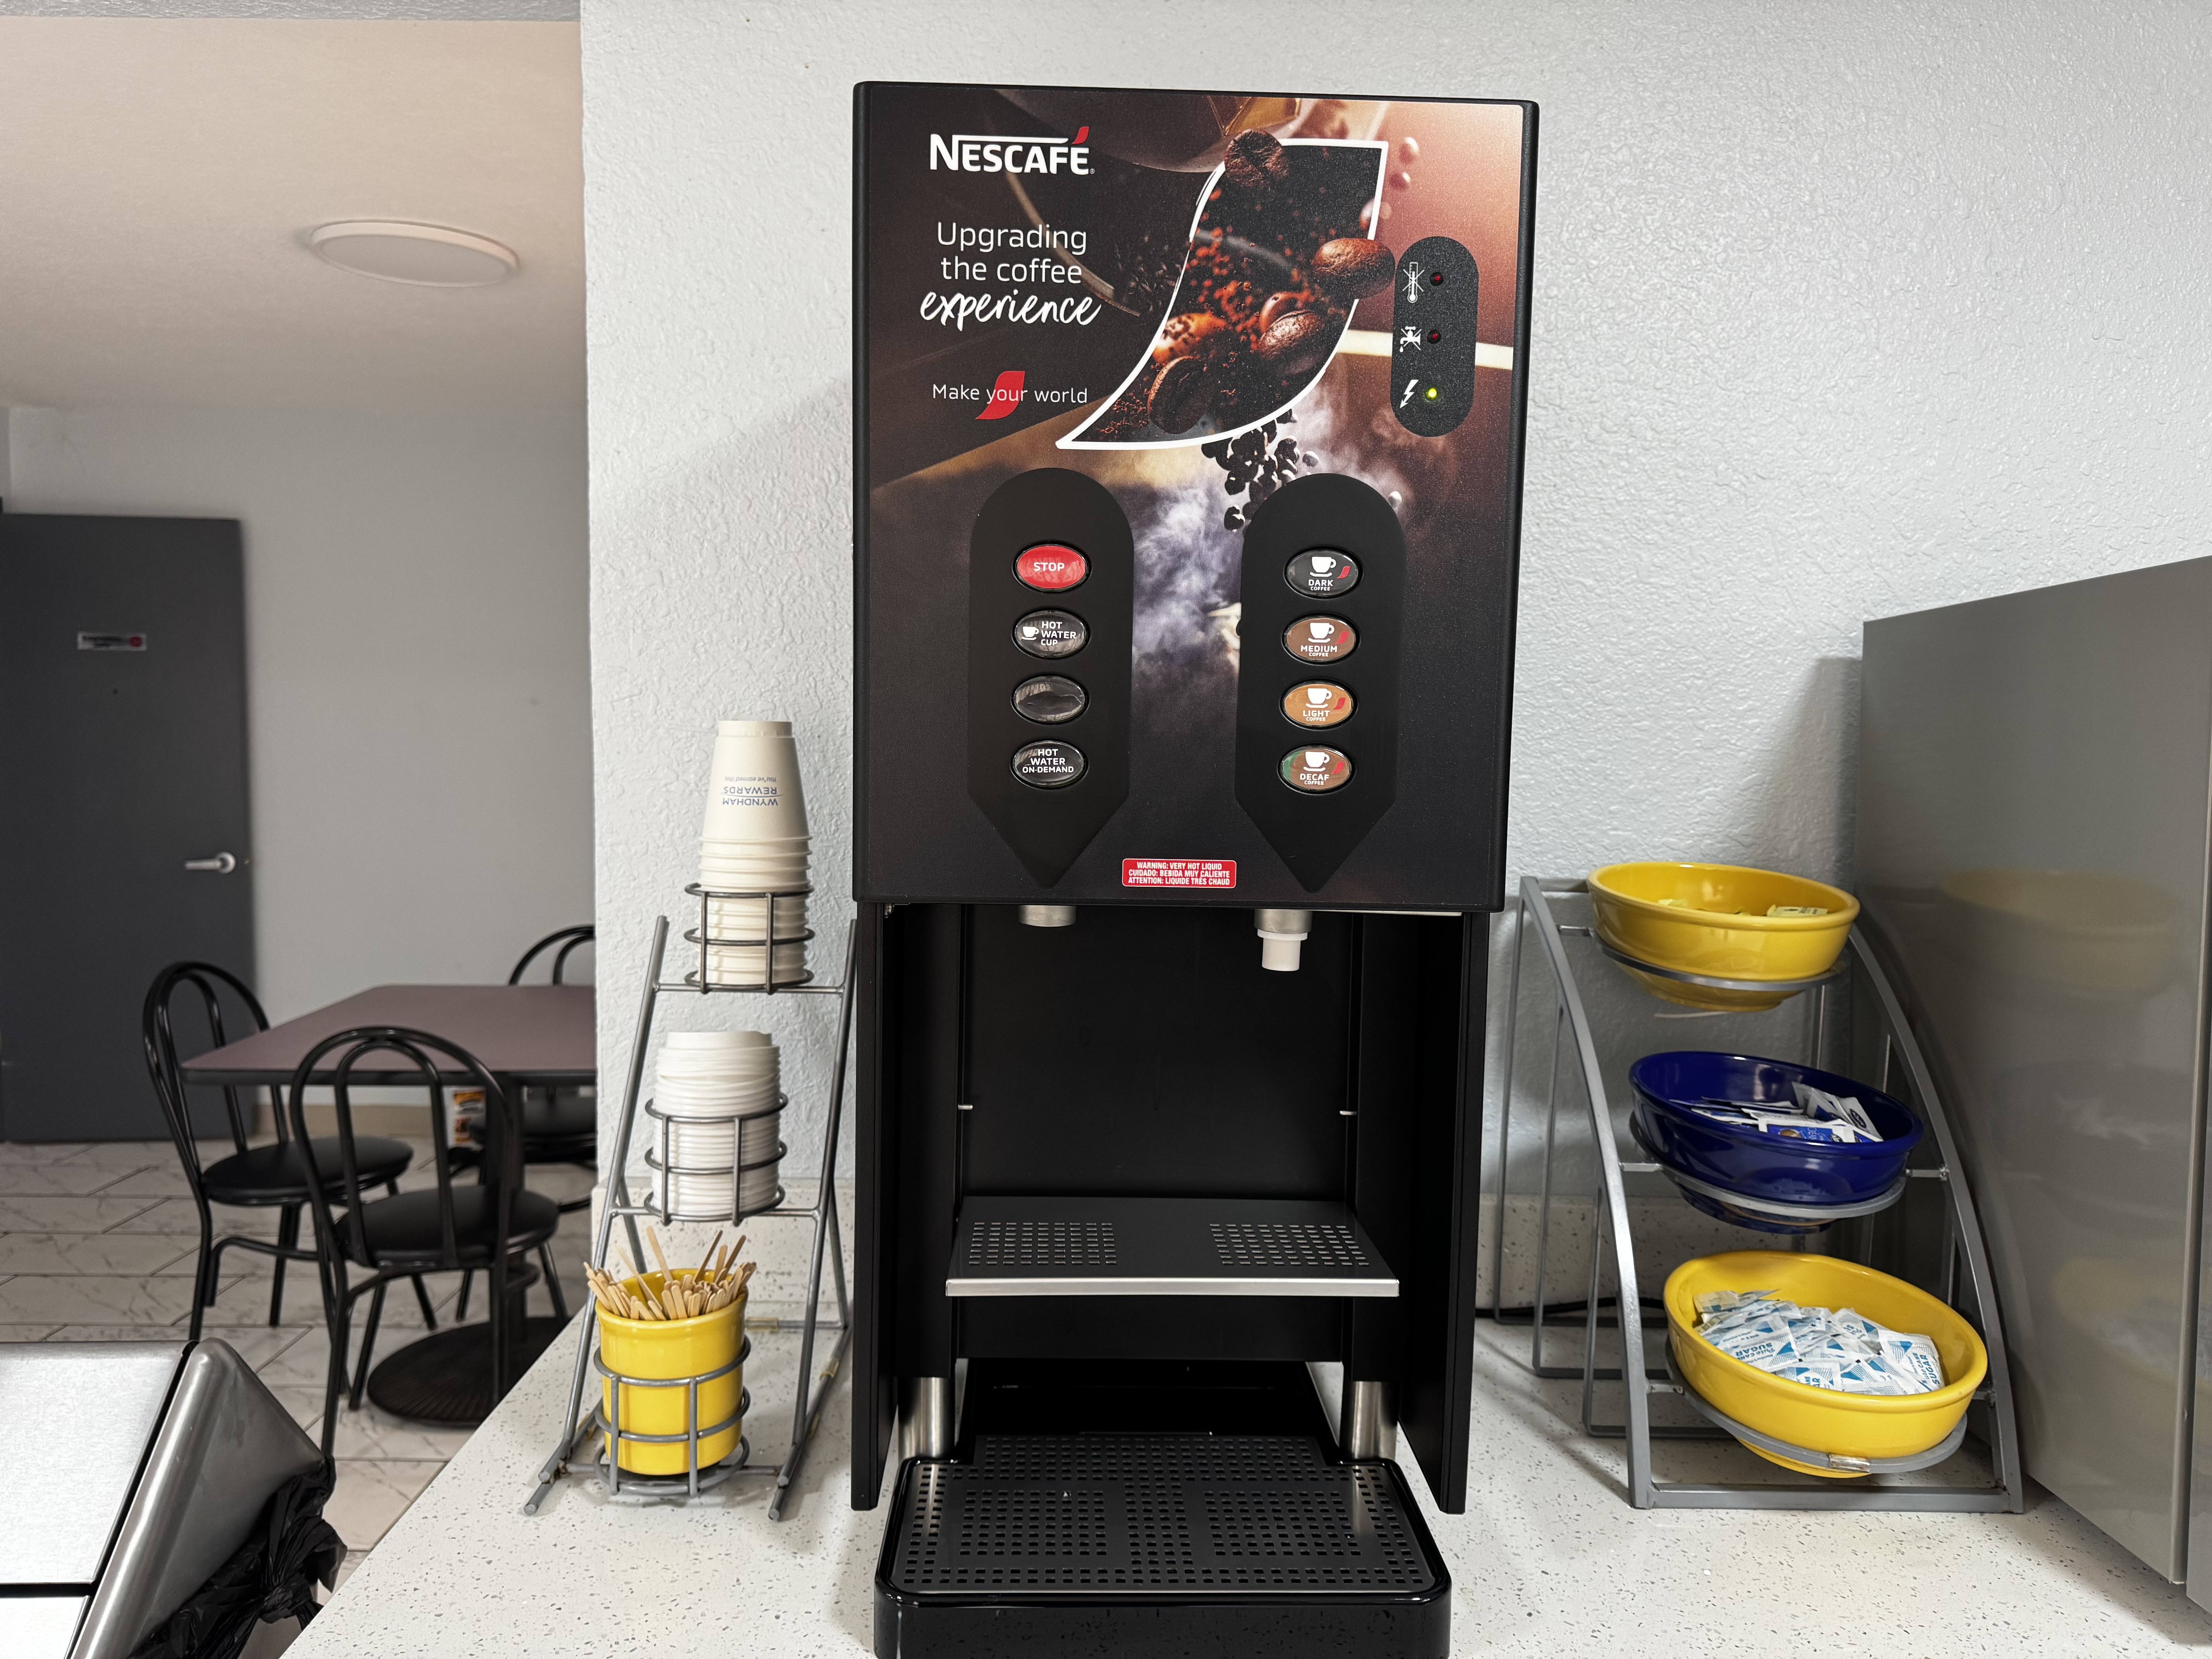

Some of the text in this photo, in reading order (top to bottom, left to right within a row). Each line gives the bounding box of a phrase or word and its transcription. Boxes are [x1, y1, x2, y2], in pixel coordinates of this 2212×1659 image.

[930, 127, 1089, 175] NESCAFÉ
[938, 222, 1086, 255] Upgrading
[941, 256, 1082, 283] the coffee
[920, 289, 1102, 331] experience
[933, 384, 1087, 404] Make your world
[1034, 562, 1065, 572] STOP
[1041, 630, 1076, 639] WATER
[1042, 621, 1062, 629] HOT
[1735, 1343, 1772, 1357] SUGAR
[1912, 1353, 1923, 1367] CANE
[1920, 1355, 1940, 1384] SUGAR
